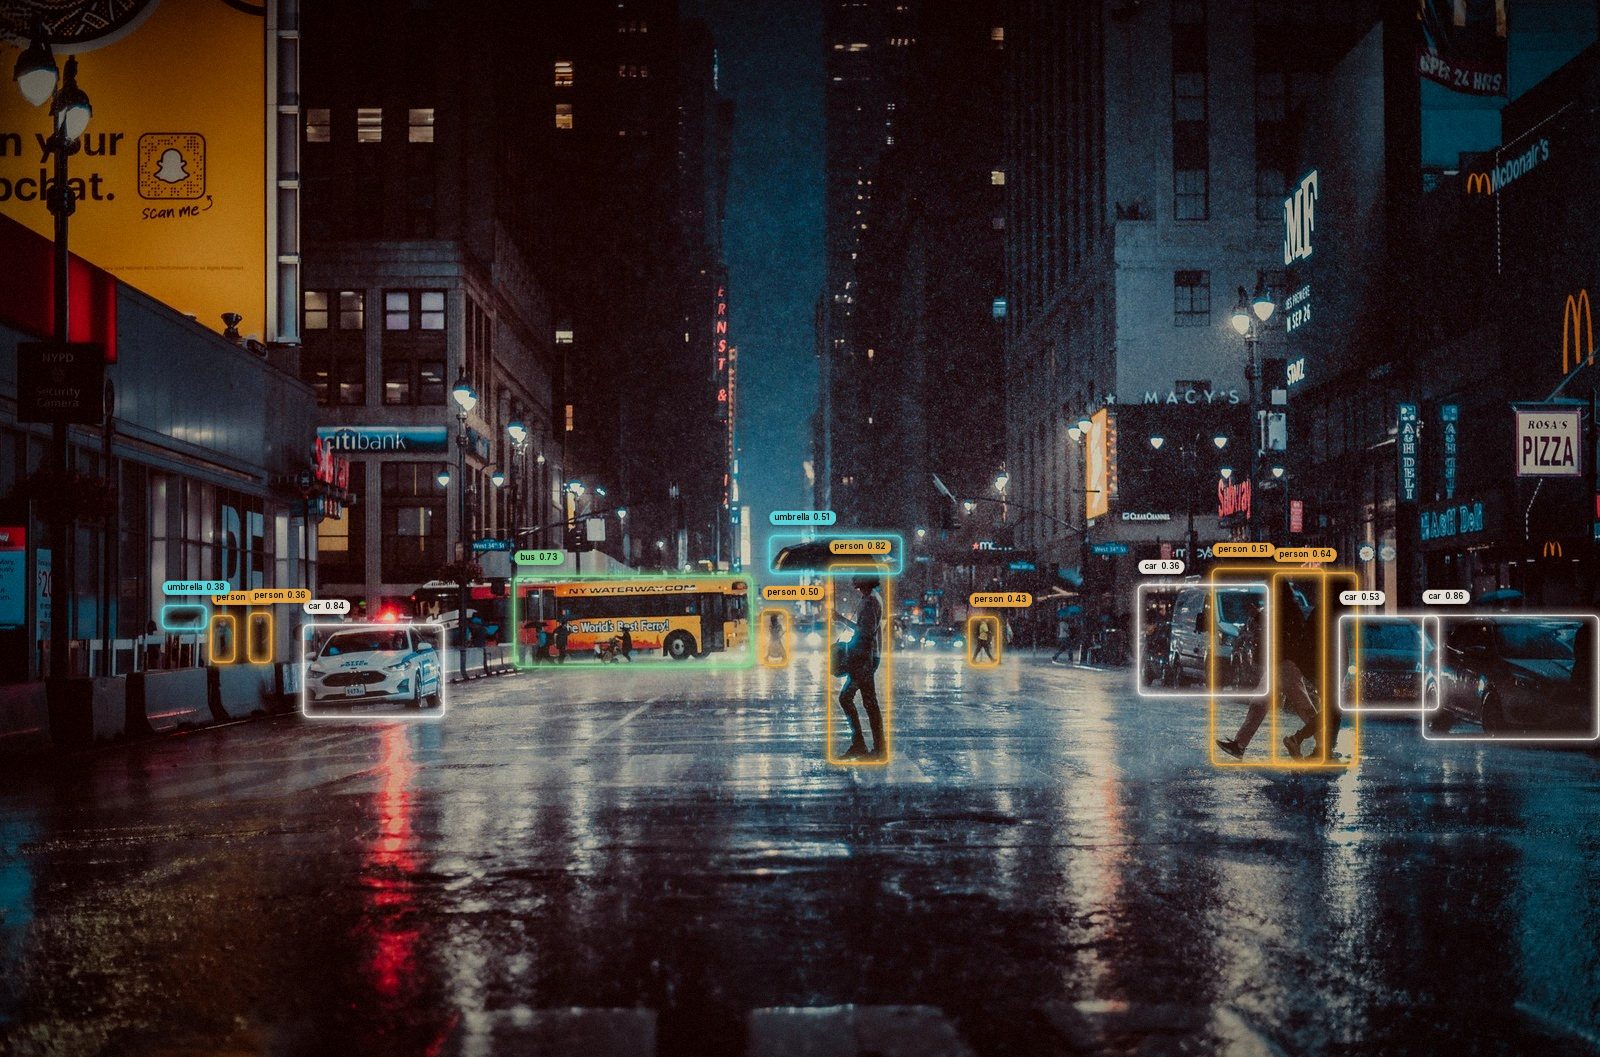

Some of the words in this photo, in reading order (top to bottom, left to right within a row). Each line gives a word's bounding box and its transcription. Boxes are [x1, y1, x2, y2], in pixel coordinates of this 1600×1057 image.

[142, 207, 175, 219] scan
[179, 204, 200, 216] me
[1292, 309, 1302, 329] SEP
[1303, 304, 1311, 322] 26
[42, 352, 74, 362] NYPD
[36, 386, 81, 399] Security
[1144, 390, 1240, 404] MACY'S
[37, 397, 80, 408] Camera
[1527, 420, 1568, 430] ROSA'S
[324, 430, 407, 450] citibank
[1523, 435, 1574, 466] PIZZA
[1403, 457, 1415, 500] DELI
[566, 622, 579, 632] he
[581, 620, 614, 633] World's
[640, 619, 670, 632] Ferry!
